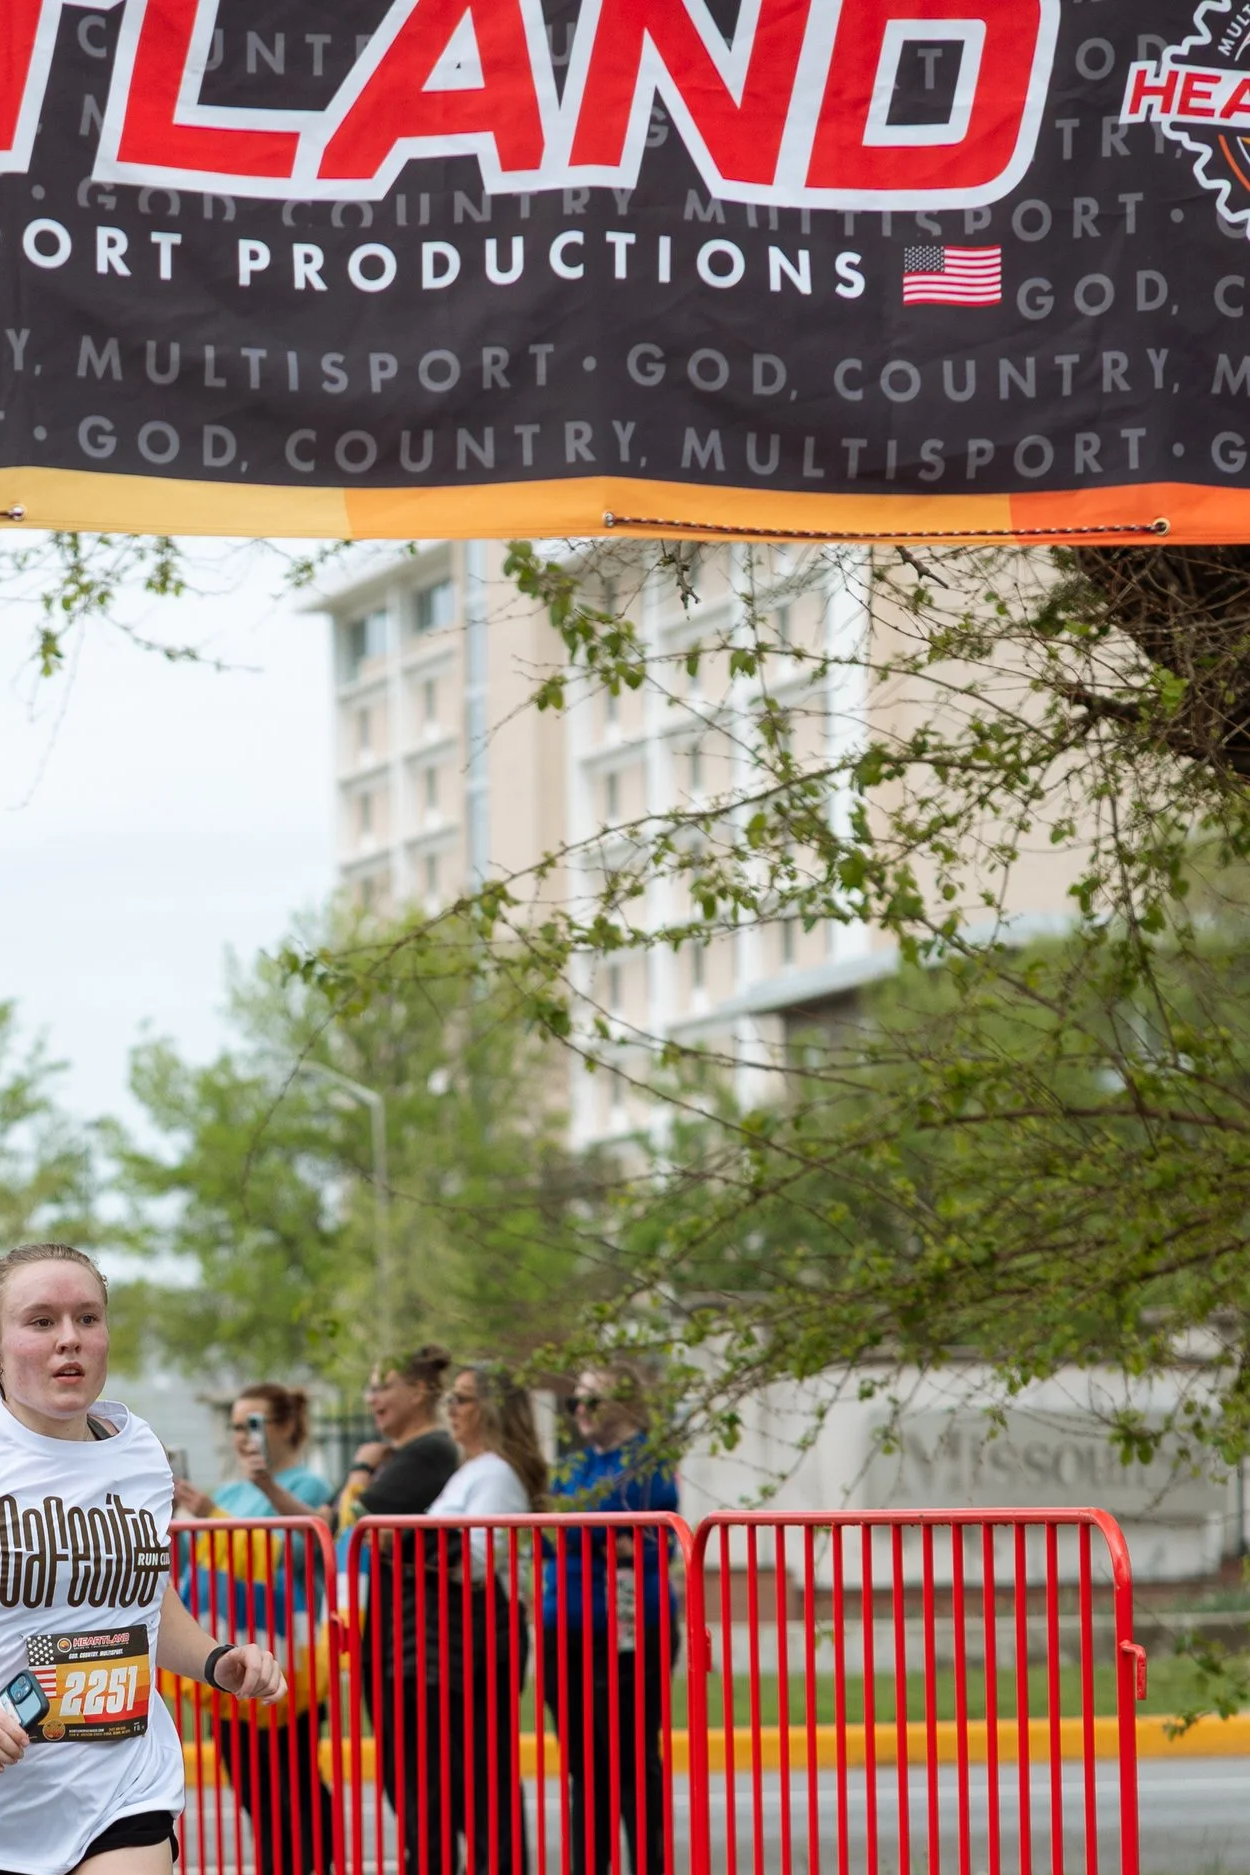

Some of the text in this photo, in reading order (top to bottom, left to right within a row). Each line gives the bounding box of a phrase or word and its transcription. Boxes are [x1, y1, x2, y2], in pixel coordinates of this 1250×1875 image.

[239, 231, 867, 300] PRODUCTIONS
[1017, 270, 1179, 321] GOD,
[77, 336, 556, 396] MULTISPORT
[627, 344, 798, 401] GOD,
[834, 349, 1180, 405] COUNTRY,
[77, 415, 250, 475] GOD,
[285, 420, 648, 475] COUNTRY,
[681, 427, 1148, 480] MULTISPORT
[137, 1552, 159, 1566] RUN
[59, 1665, 138, 1717] 2251
